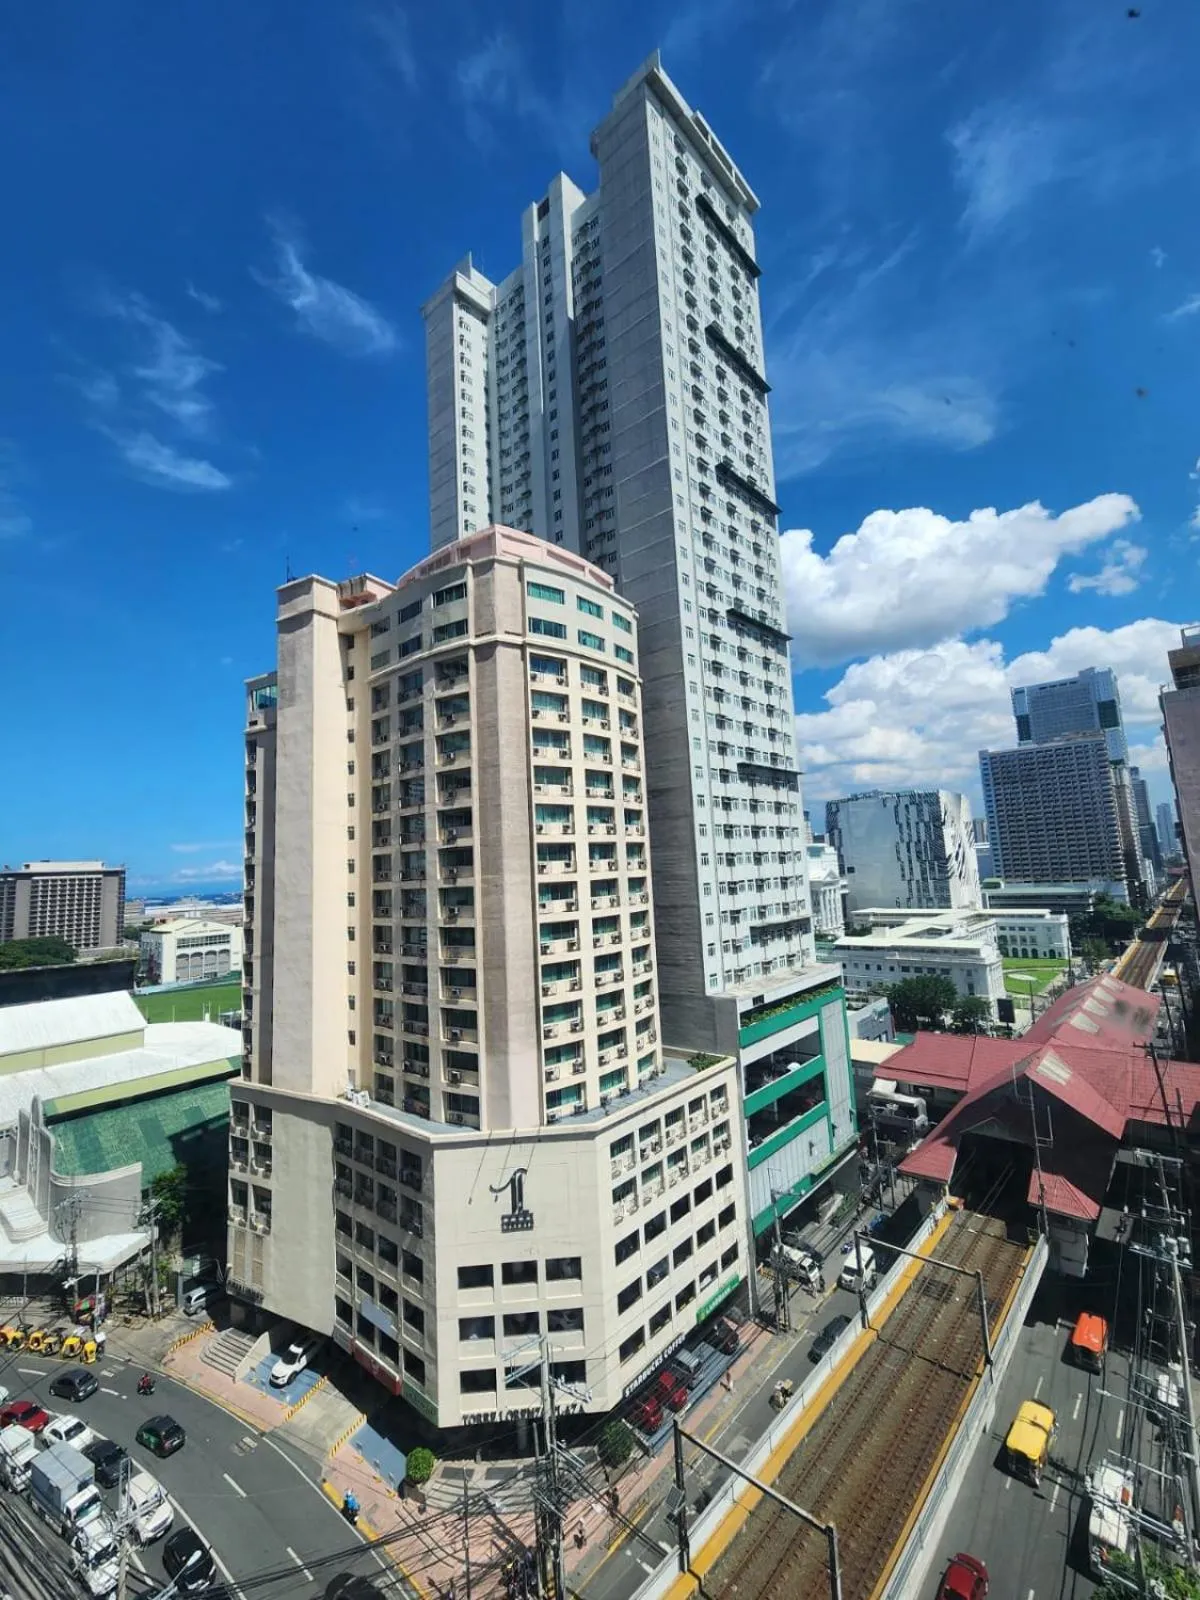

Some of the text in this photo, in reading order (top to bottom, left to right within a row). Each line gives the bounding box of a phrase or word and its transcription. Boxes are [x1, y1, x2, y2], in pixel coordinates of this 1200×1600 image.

[625, 1333, 686, 1398] STARBUCKS COFFEE
[462, 1412, 497, 1425] TORRE
[498, 1407, 545, 1421] LORENZ
